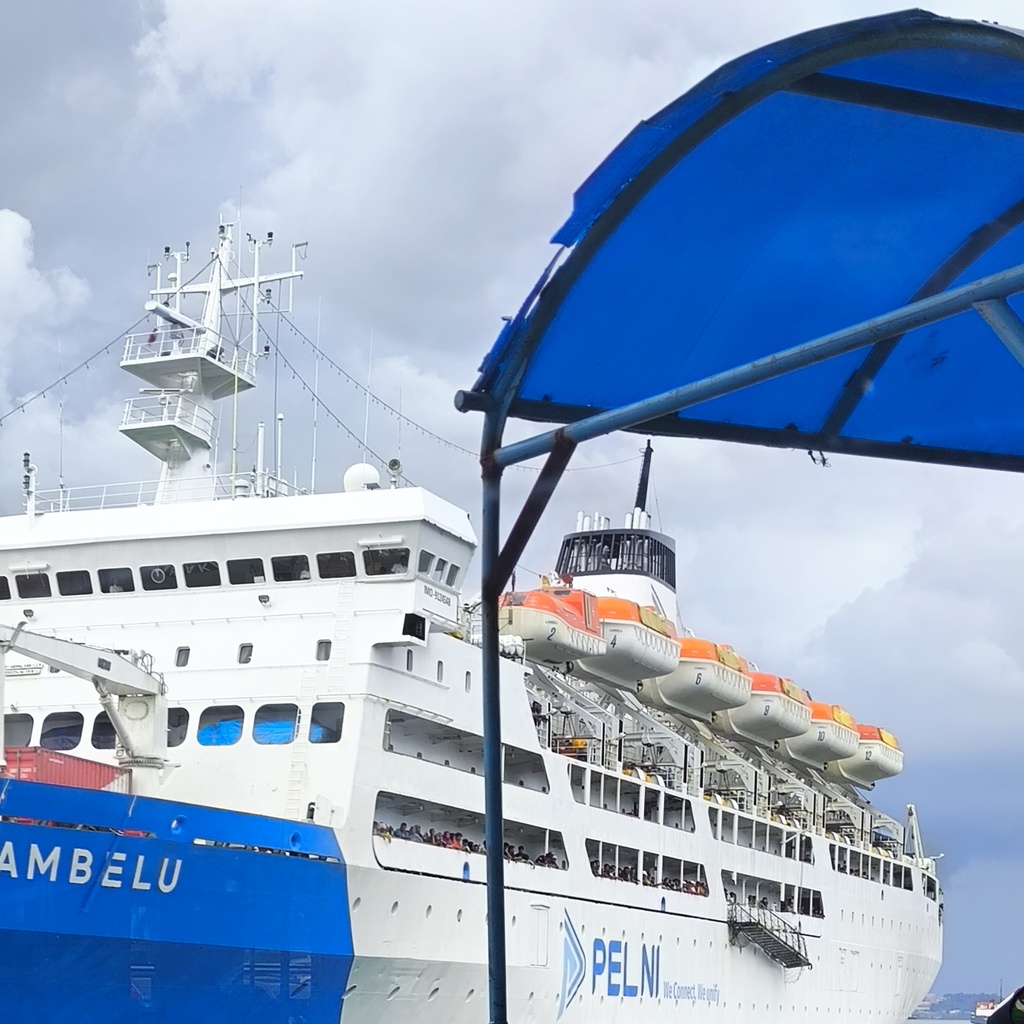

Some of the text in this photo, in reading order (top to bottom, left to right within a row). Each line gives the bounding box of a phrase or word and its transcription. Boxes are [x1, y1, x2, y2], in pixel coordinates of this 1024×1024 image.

[546, 627, 557, 642] 2
[610, 634, 618, 649] 4
[695, 673, 703, 686] 6
[763, 704, 771, 717] 8
[817, 731, 825, 742] 10
[864, 750, 873, 761] 12
[591, 937, 661, 999] PELNI
